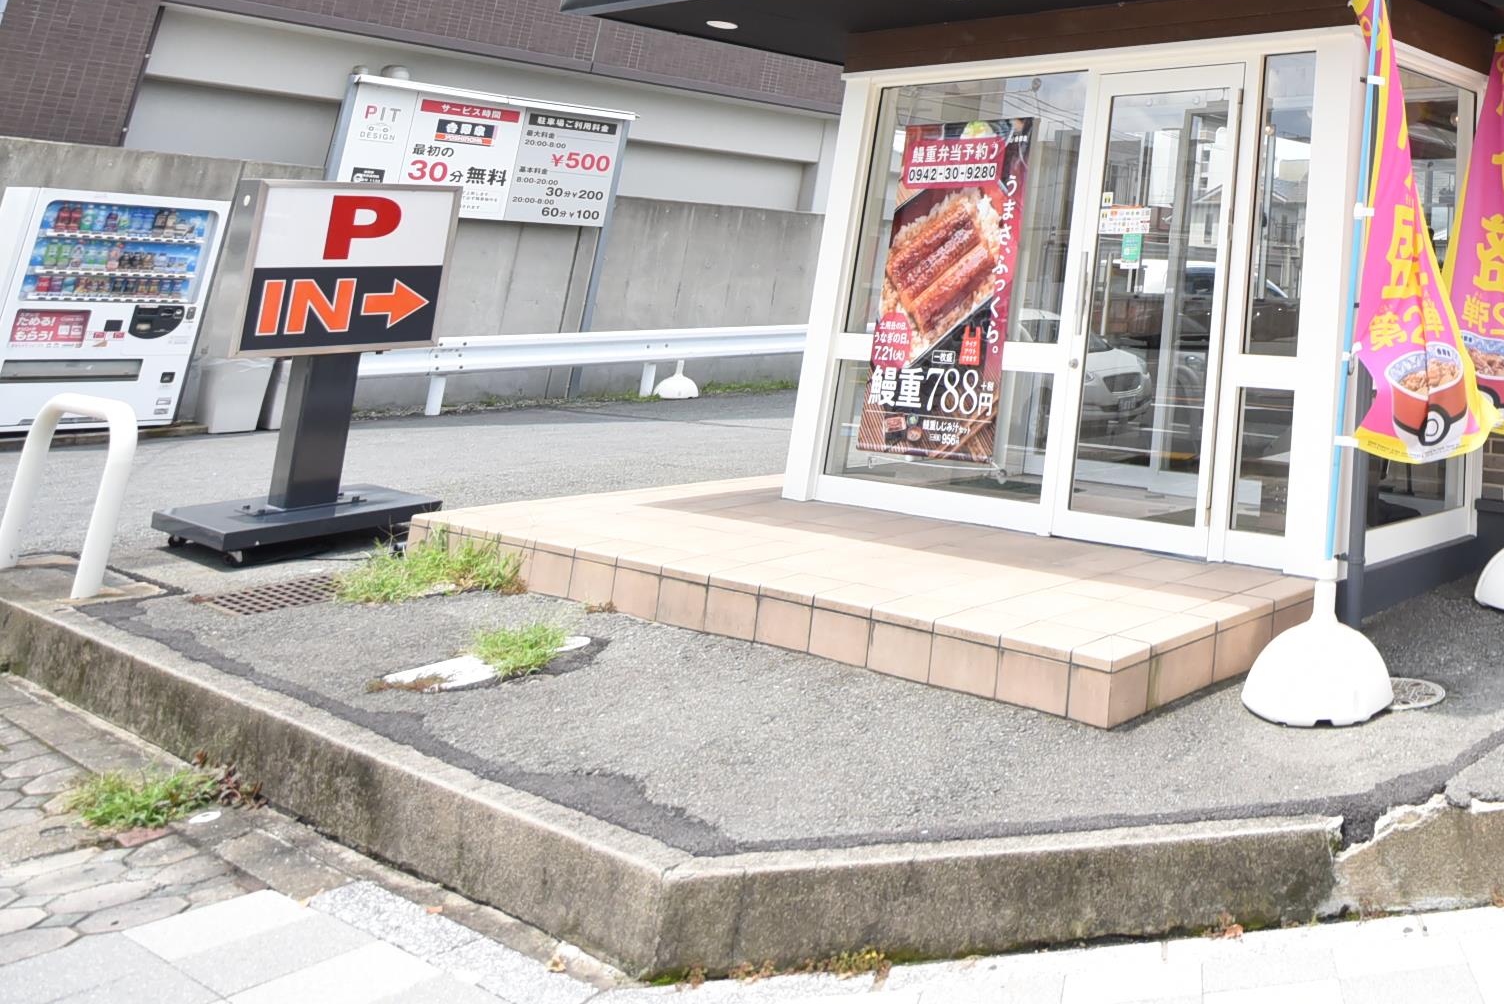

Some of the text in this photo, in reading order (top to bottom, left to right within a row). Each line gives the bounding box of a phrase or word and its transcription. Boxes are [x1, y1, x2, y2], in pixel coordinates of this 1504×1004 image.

[365, 105, 401, 123] PIT
[441, 103, 501, 119] サービス時間
[537, 116, 610, 133] 駐車場ご利用料金
[359, 131, 395, 141] DESIGN
[526, 129, 555, 139] 最大料金
[412, 143, 454, 158] 最初の
[911, 144, 988, 164] 鰻重弁当予約
[551, 152, 611, 172] ¥500
[408, 159, 507, 187] 30分無料
[908, 165, 996, 182] 0942-30-9280
[322, 194, 402, 260] P
[255, 278, 358, 336] IN
